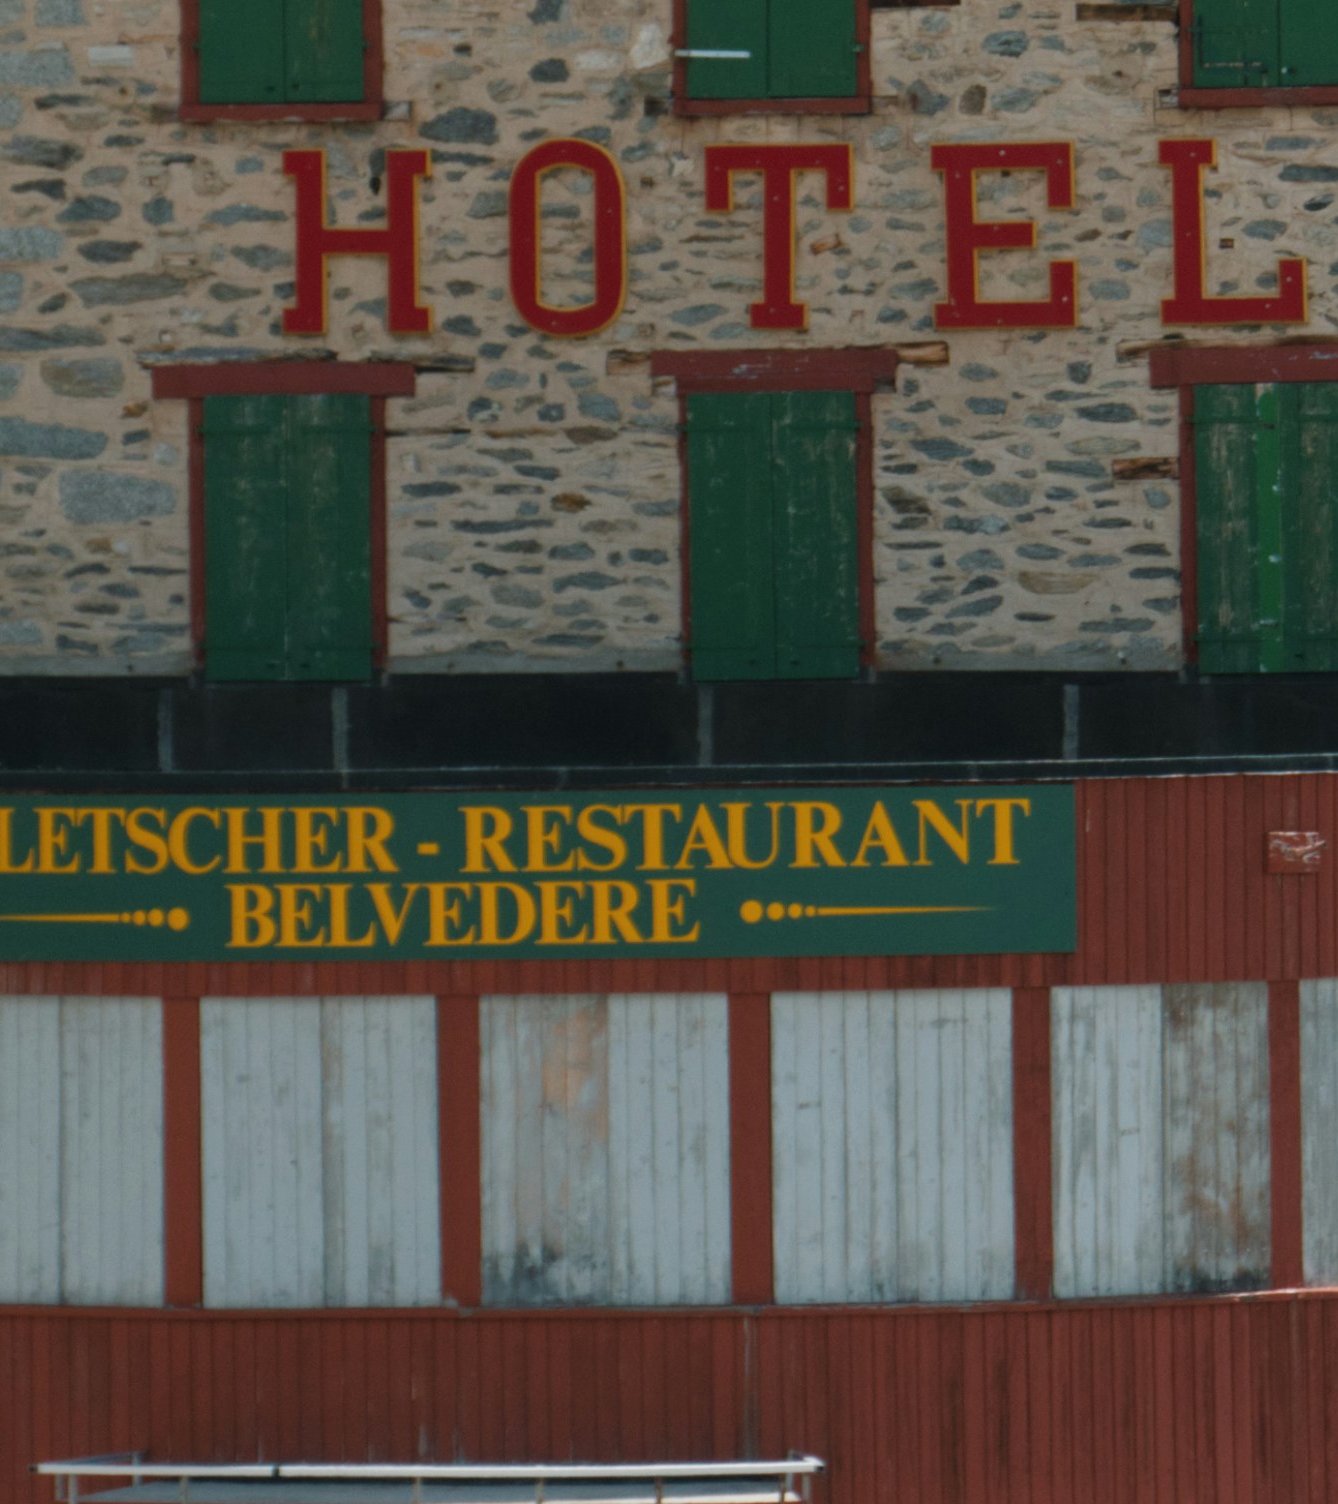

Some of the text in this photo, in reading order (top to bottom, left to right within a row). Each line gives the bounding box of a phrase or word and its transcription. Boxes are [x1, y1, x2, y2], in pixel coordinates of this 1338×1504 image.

[283, 139, 1307, 335] HOTEL
[462, 798, 1031, 873] RESTAURANT
[227, 878, 701, 947] BELVEDERE
